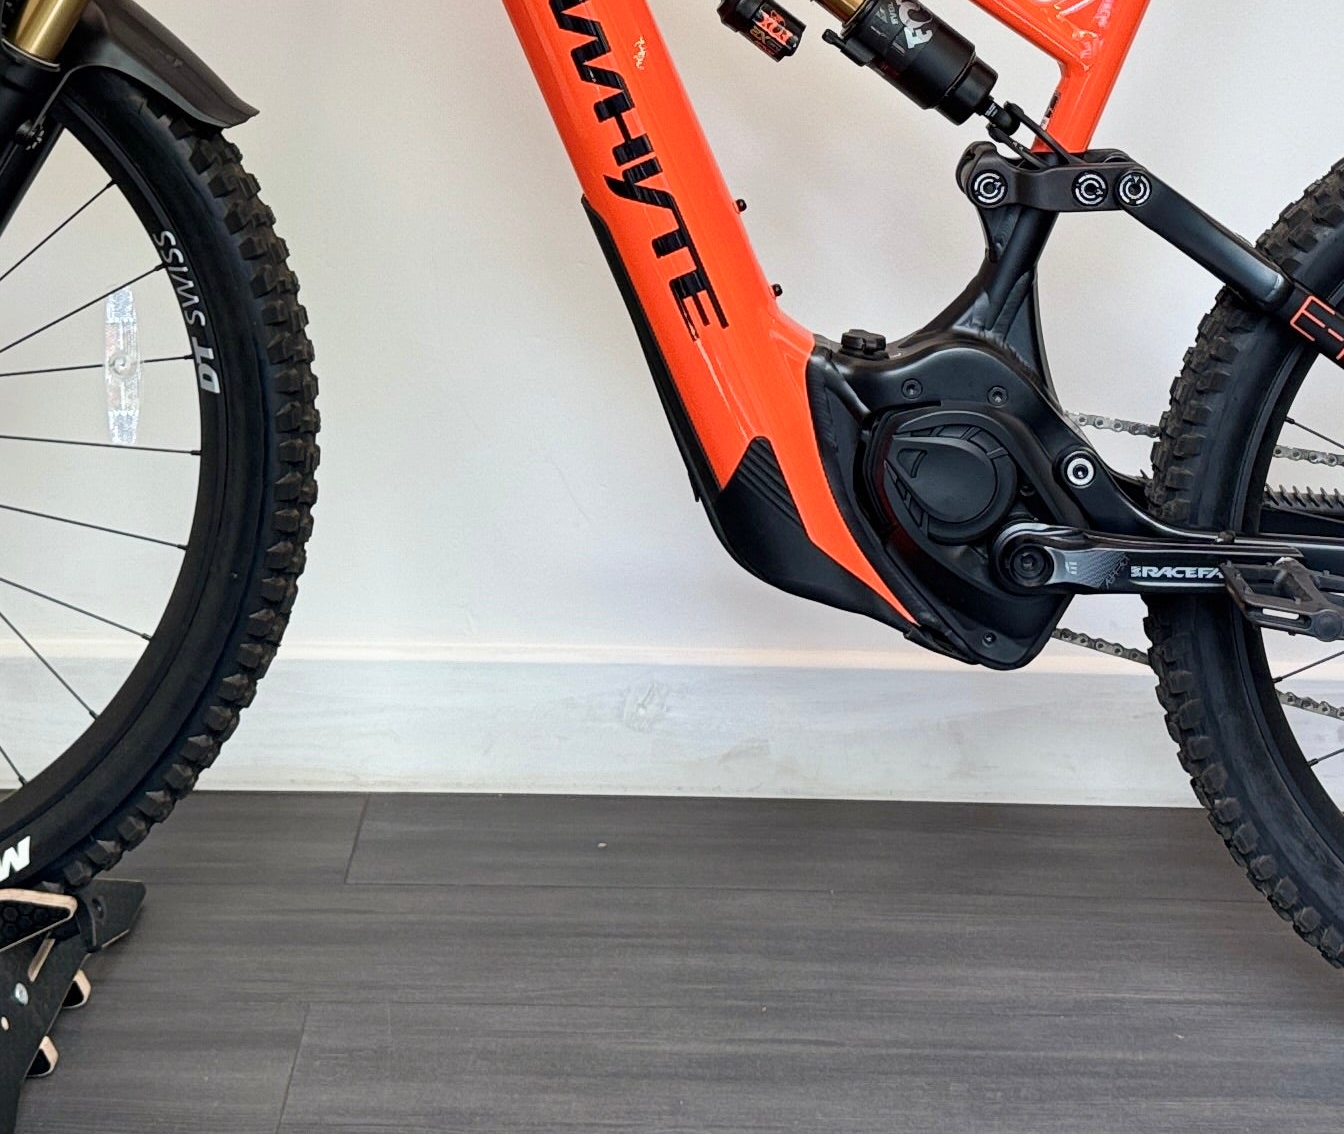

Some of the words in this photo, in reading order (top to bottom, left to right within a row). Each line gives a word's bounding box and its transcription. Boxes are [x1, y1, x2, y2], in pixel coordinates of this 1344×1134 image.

[152, 231, 206, 326] SWISS
[192, 337, 220, 394] DT
[1142, 566, 1224, 579] RACEFA
